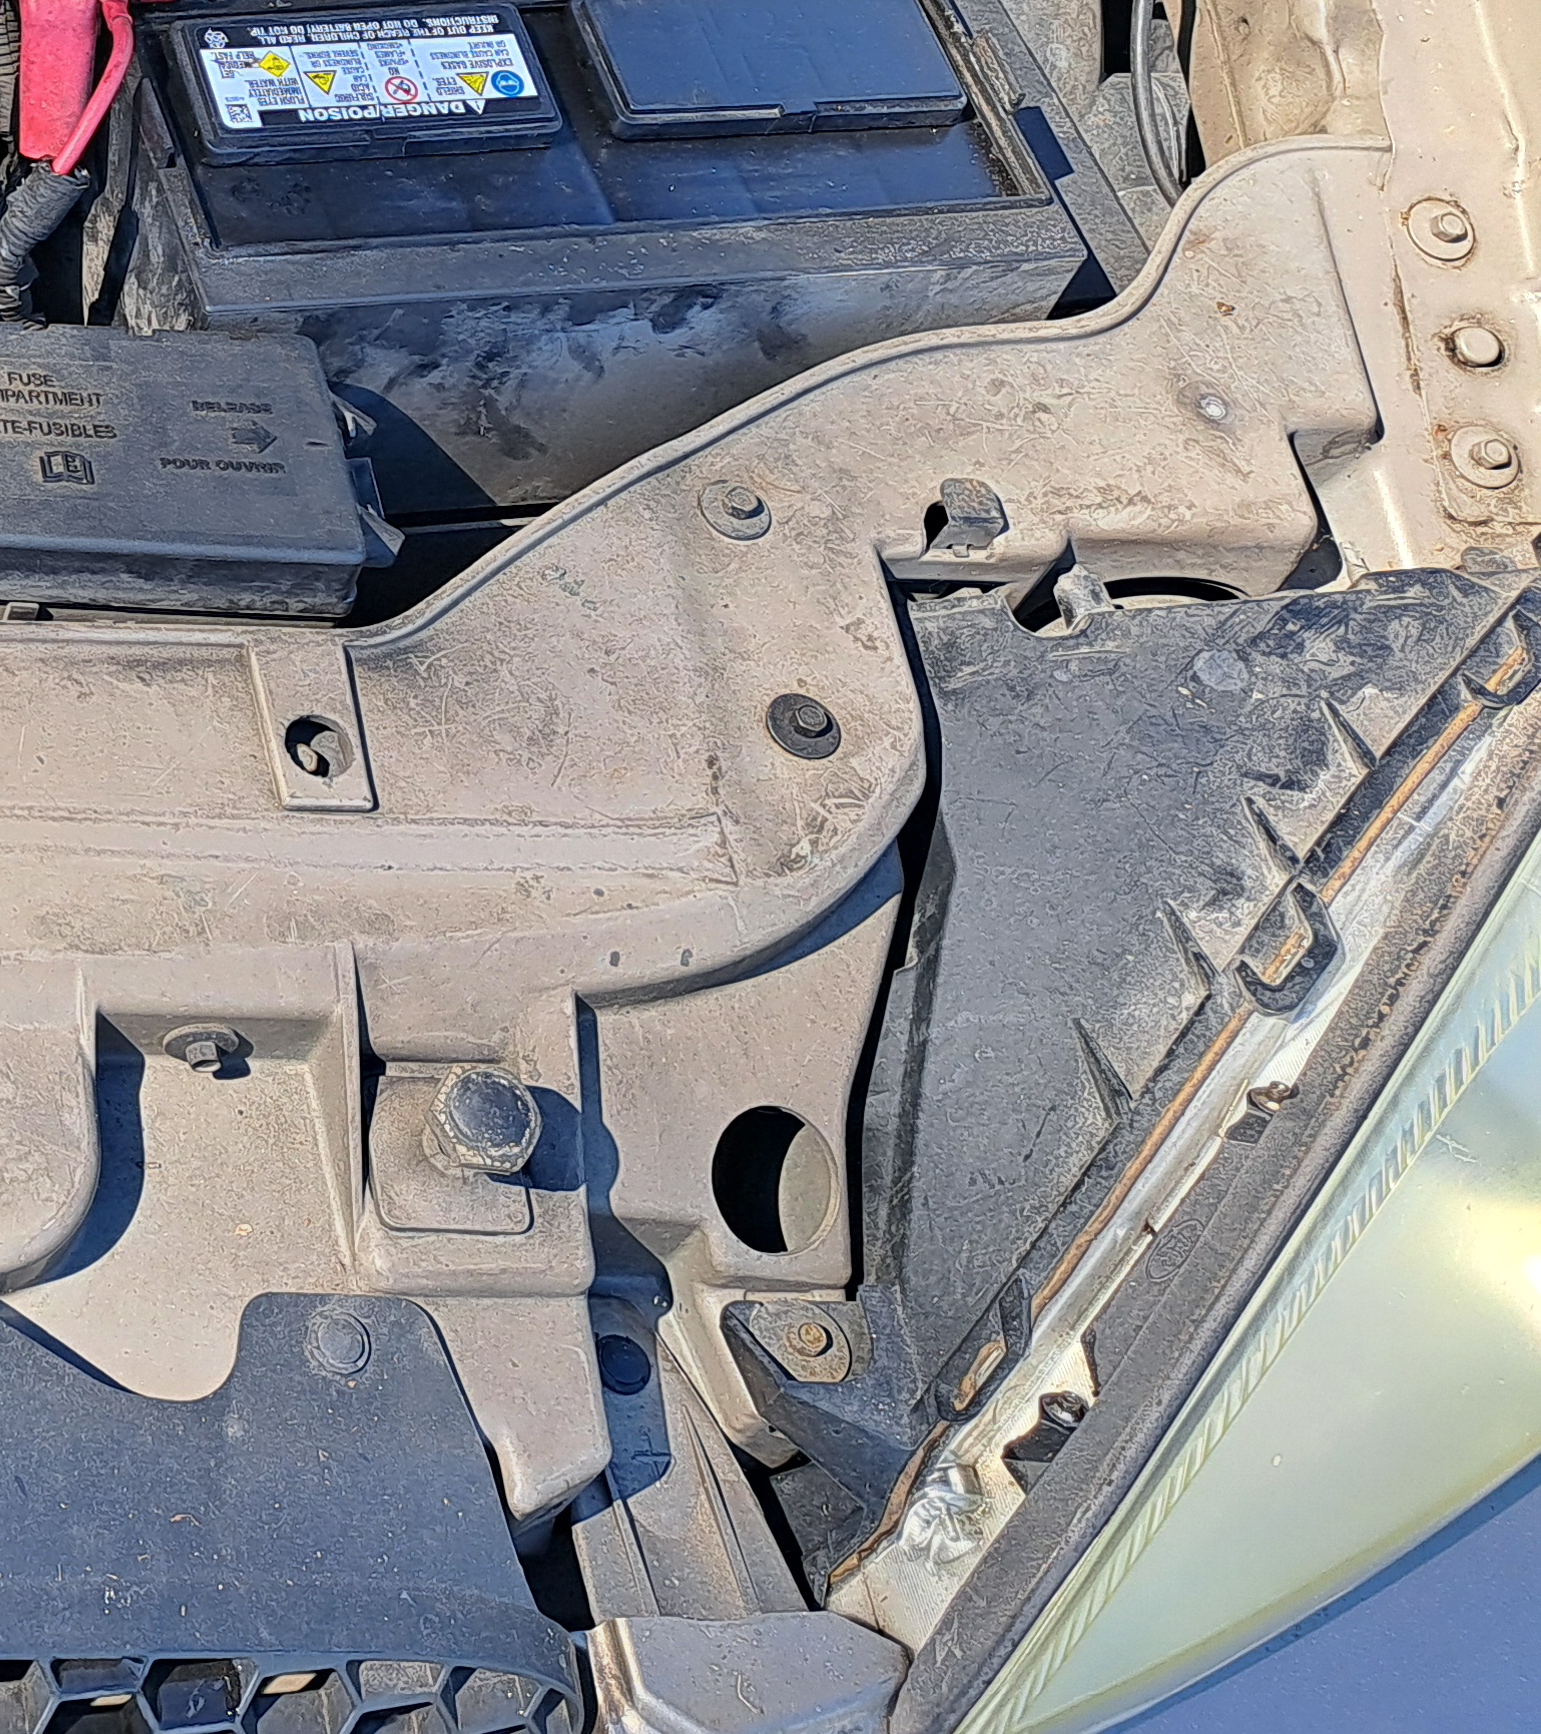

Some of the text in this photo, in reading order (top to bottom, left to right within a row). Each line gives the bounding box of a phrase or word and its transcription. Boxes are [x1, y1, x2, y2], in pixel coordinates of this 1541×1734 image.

[388, 67, 400, 76] NO
[351, 83, 370, 92] ACID
[298, 100, 466, 123] DANGER/POISON
[6, 371, 57, 390] FUSE
